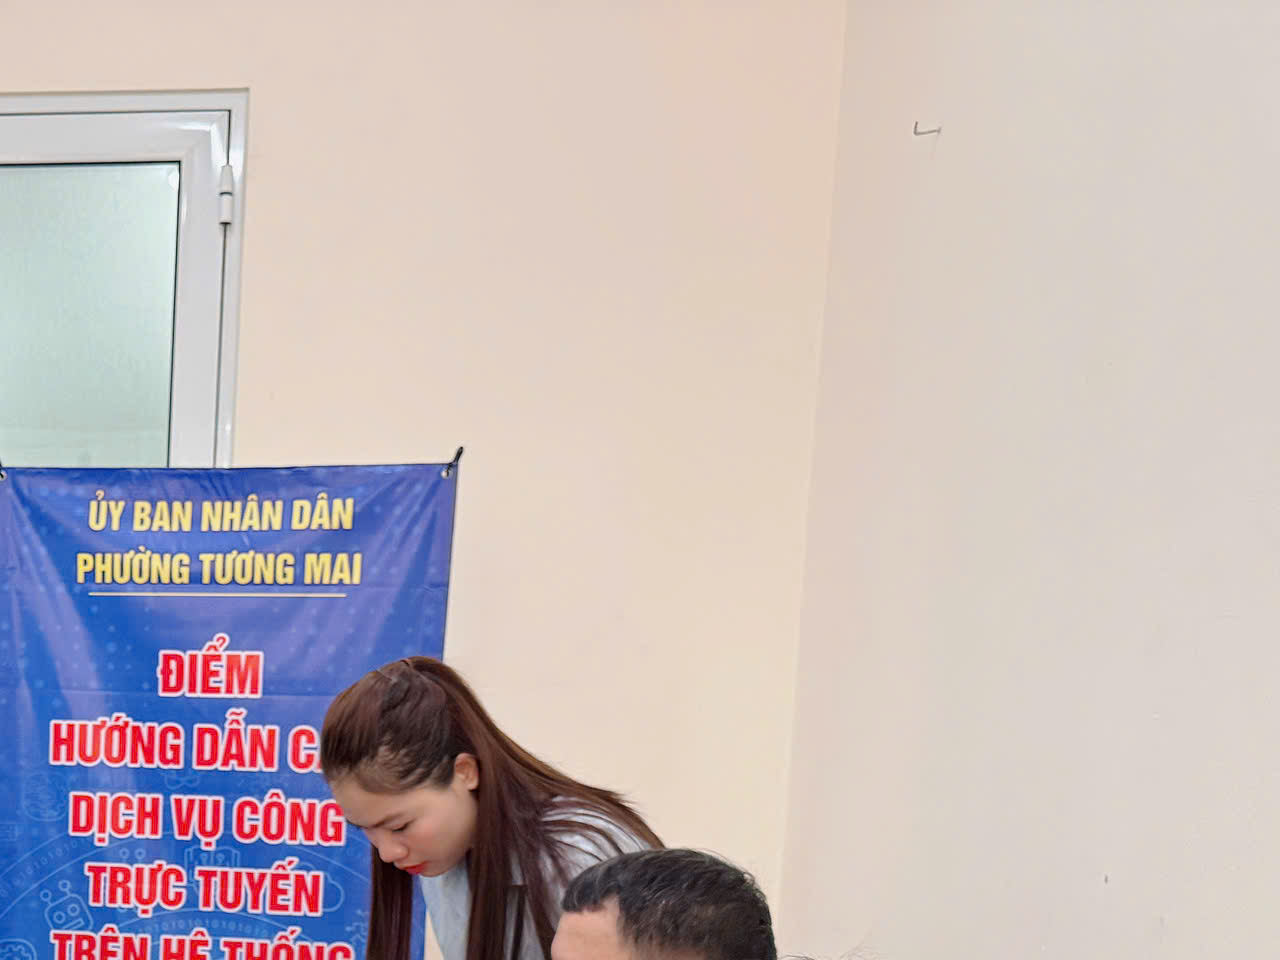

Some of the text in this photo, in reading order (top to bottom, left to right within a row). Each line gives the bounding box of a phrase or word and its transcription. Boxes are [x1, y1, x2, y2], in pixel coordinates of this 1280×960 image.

[89, 490, 354, 532] ỦY BAN NHÂN DÂN
[77, 546, 362, 585] PHƯỜNG TƯƠNG MAI
[158, 633, 264, 698] ĐIỂM
[51, 715, 182, 767] HƯỚNG
[195, 710, 277, 770] DẪN
[70, 788, 346, 848] DỊCH VỤ CÔNG
[86, 862, 185, 916] TRỰC
[196, 859, 322, 914] TUYẾN
